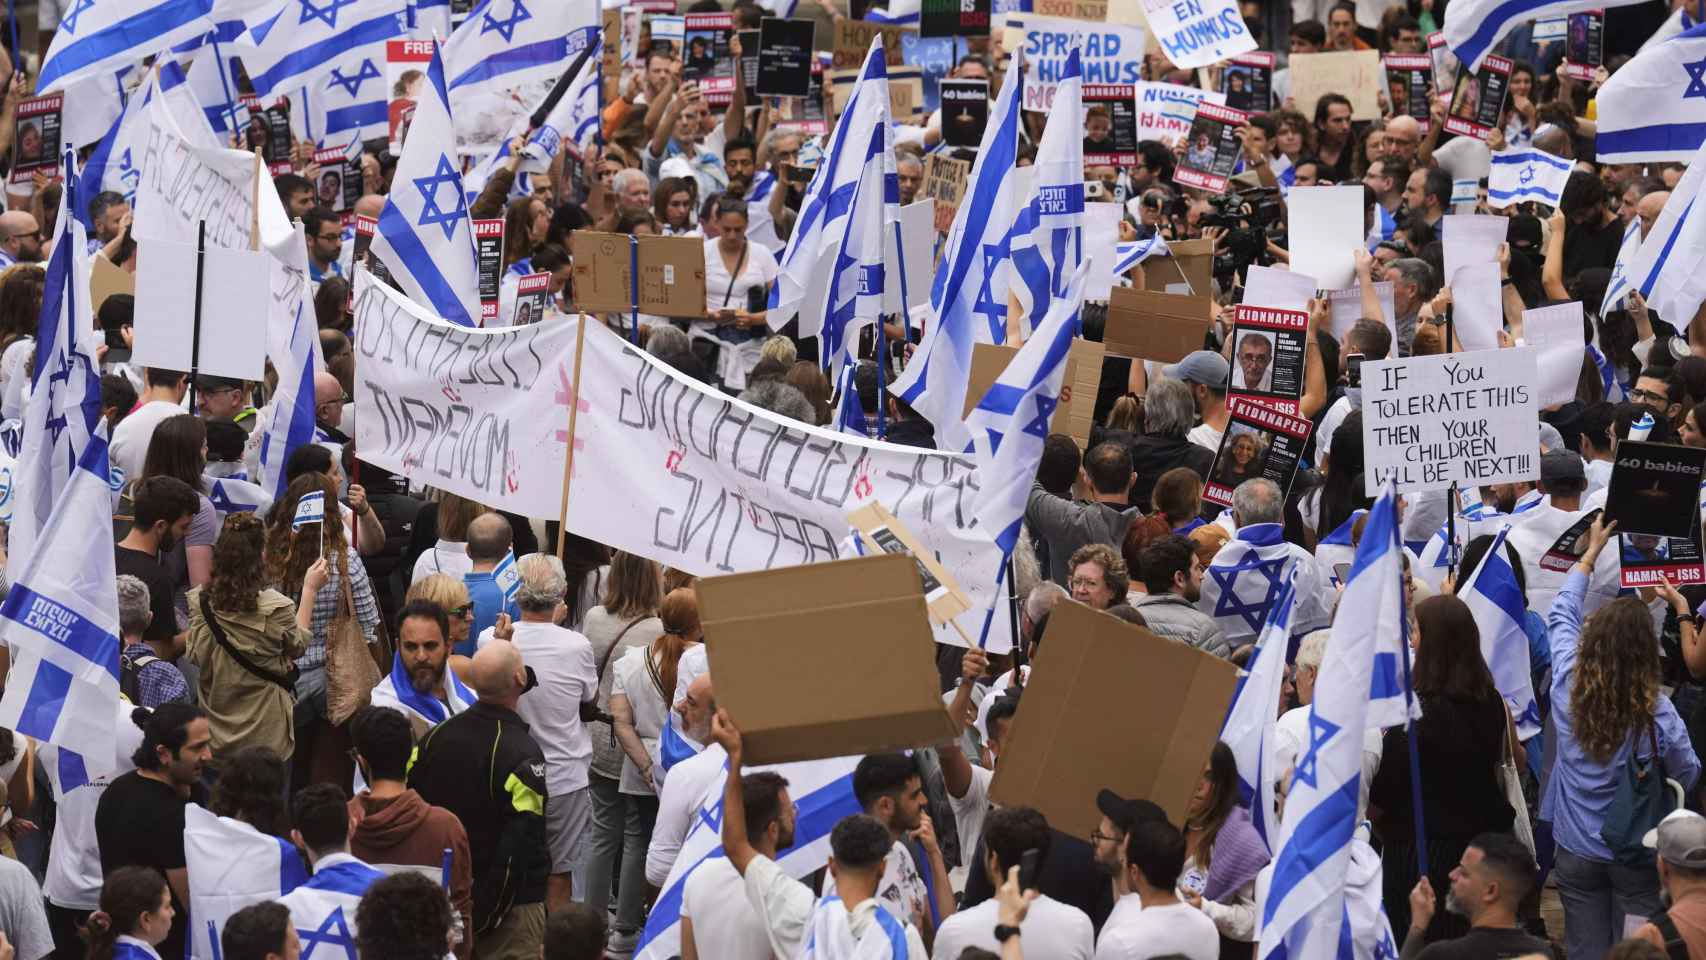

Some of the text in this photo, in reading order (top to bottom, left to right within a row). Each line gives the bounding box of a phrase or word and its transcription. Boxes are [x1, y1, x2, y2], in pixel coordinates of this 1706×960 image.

[1173, 0, 1204, 22] EN
[1025, 31, 1121, 57] SPRAD
[1162, 8, 1243, 58] HUMMUS
[403, 42, 434, 55] FRE
[1039, 59, 1140, 84] HUMUS
[942, 90, 986, 100] 40 babies
[1140, 112, 1190, 133] HAM
[1238, 309, 1305, 326] KIDNNAPED
[1381, 366, 1408, 391] IF
[1482, 385, 1529, 408] THIS
[1237, 403, 1307, 434] KIDNNAPED
[1275, 401, 1296, 415] ISIS
[1372, 418, 1489, 446] THEN YOUR
[1405, 436, 1496, 462] CHILDREN
[1374, 454, 1530, 487] WLL BE NEXT!!!
[1617, 458, 1701, 475] 40 babies
[1208, 486, 1233, 503] HAM
[1625, 570, 1666, 583] HAMAS
[1677, 568, 1701, 581] ISIS
